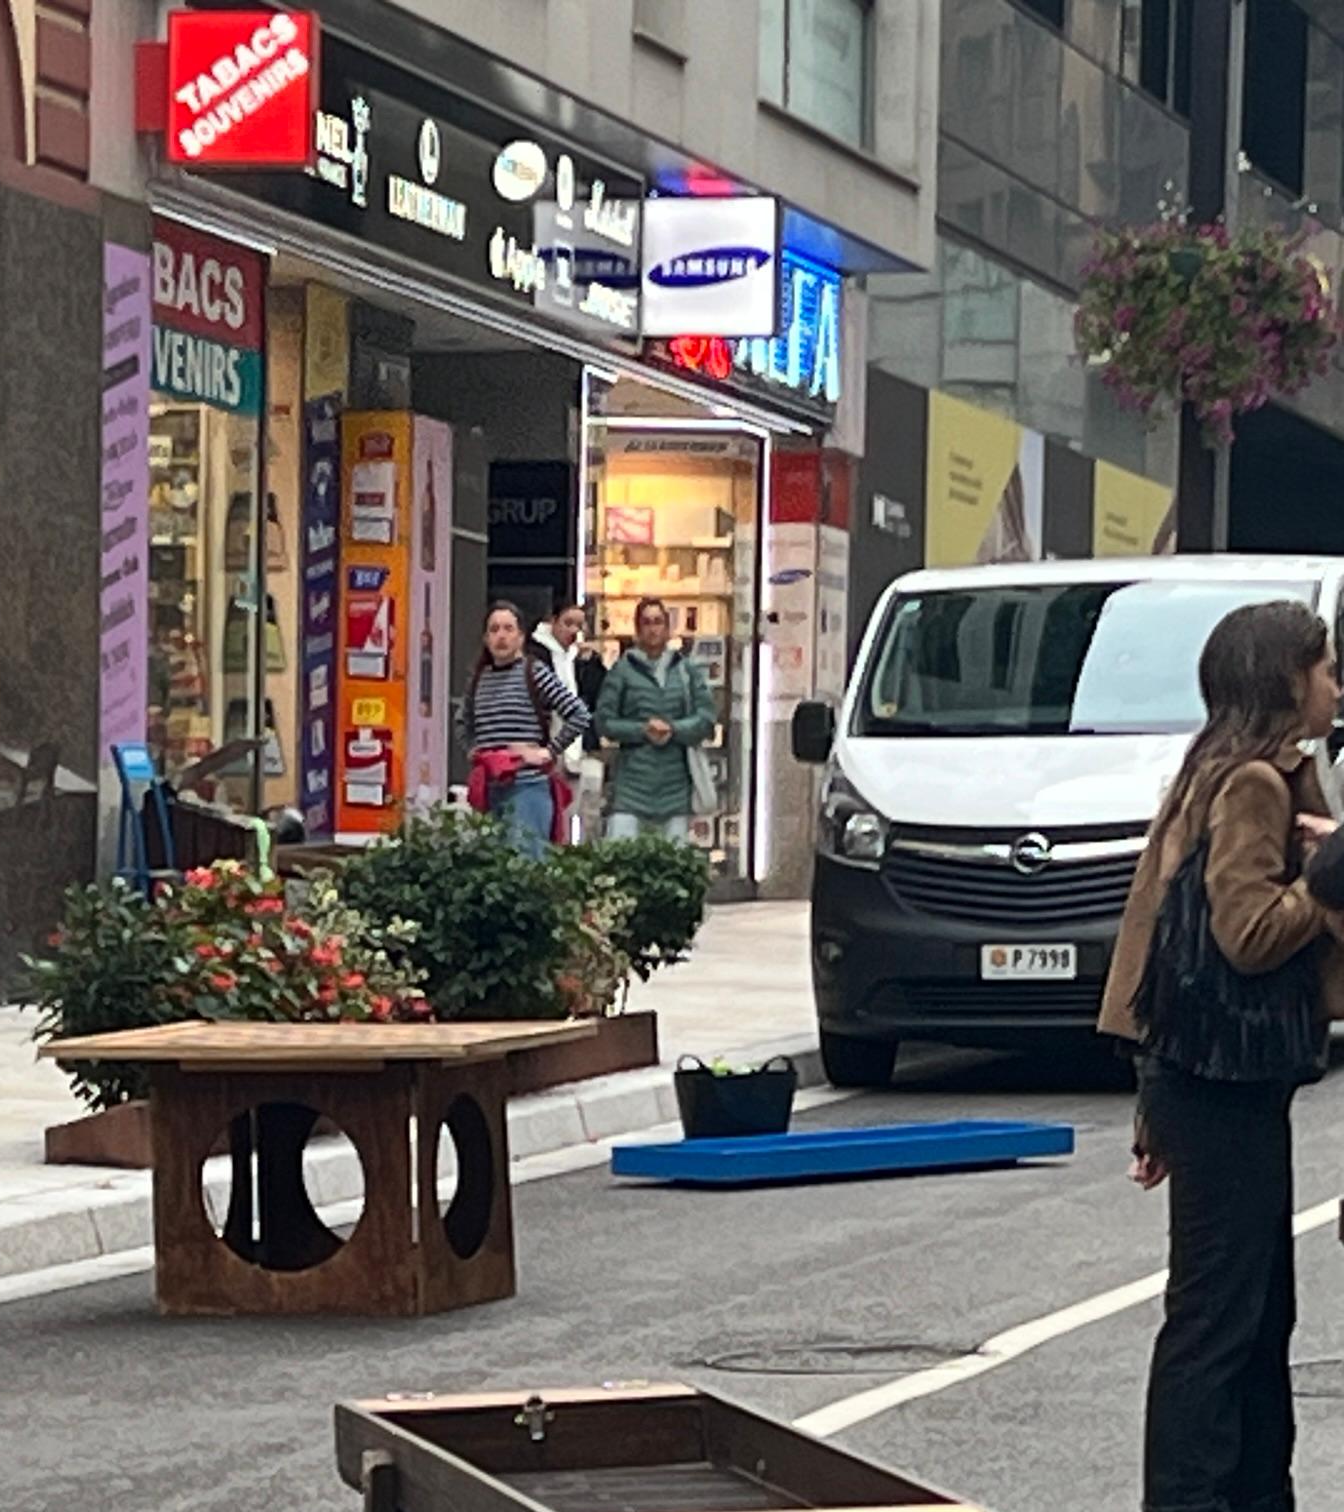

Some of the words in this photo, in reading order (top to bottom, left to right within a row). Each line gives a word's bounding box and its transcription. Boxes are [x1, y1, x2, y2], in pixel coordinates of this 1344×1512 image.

[175, 13, 297, 114] TABACS
[179, 48, 309, 157] SOUVENIRS
[152, 241, 245, 330] BACS
[153, 324, 241, 406] VENIRS
